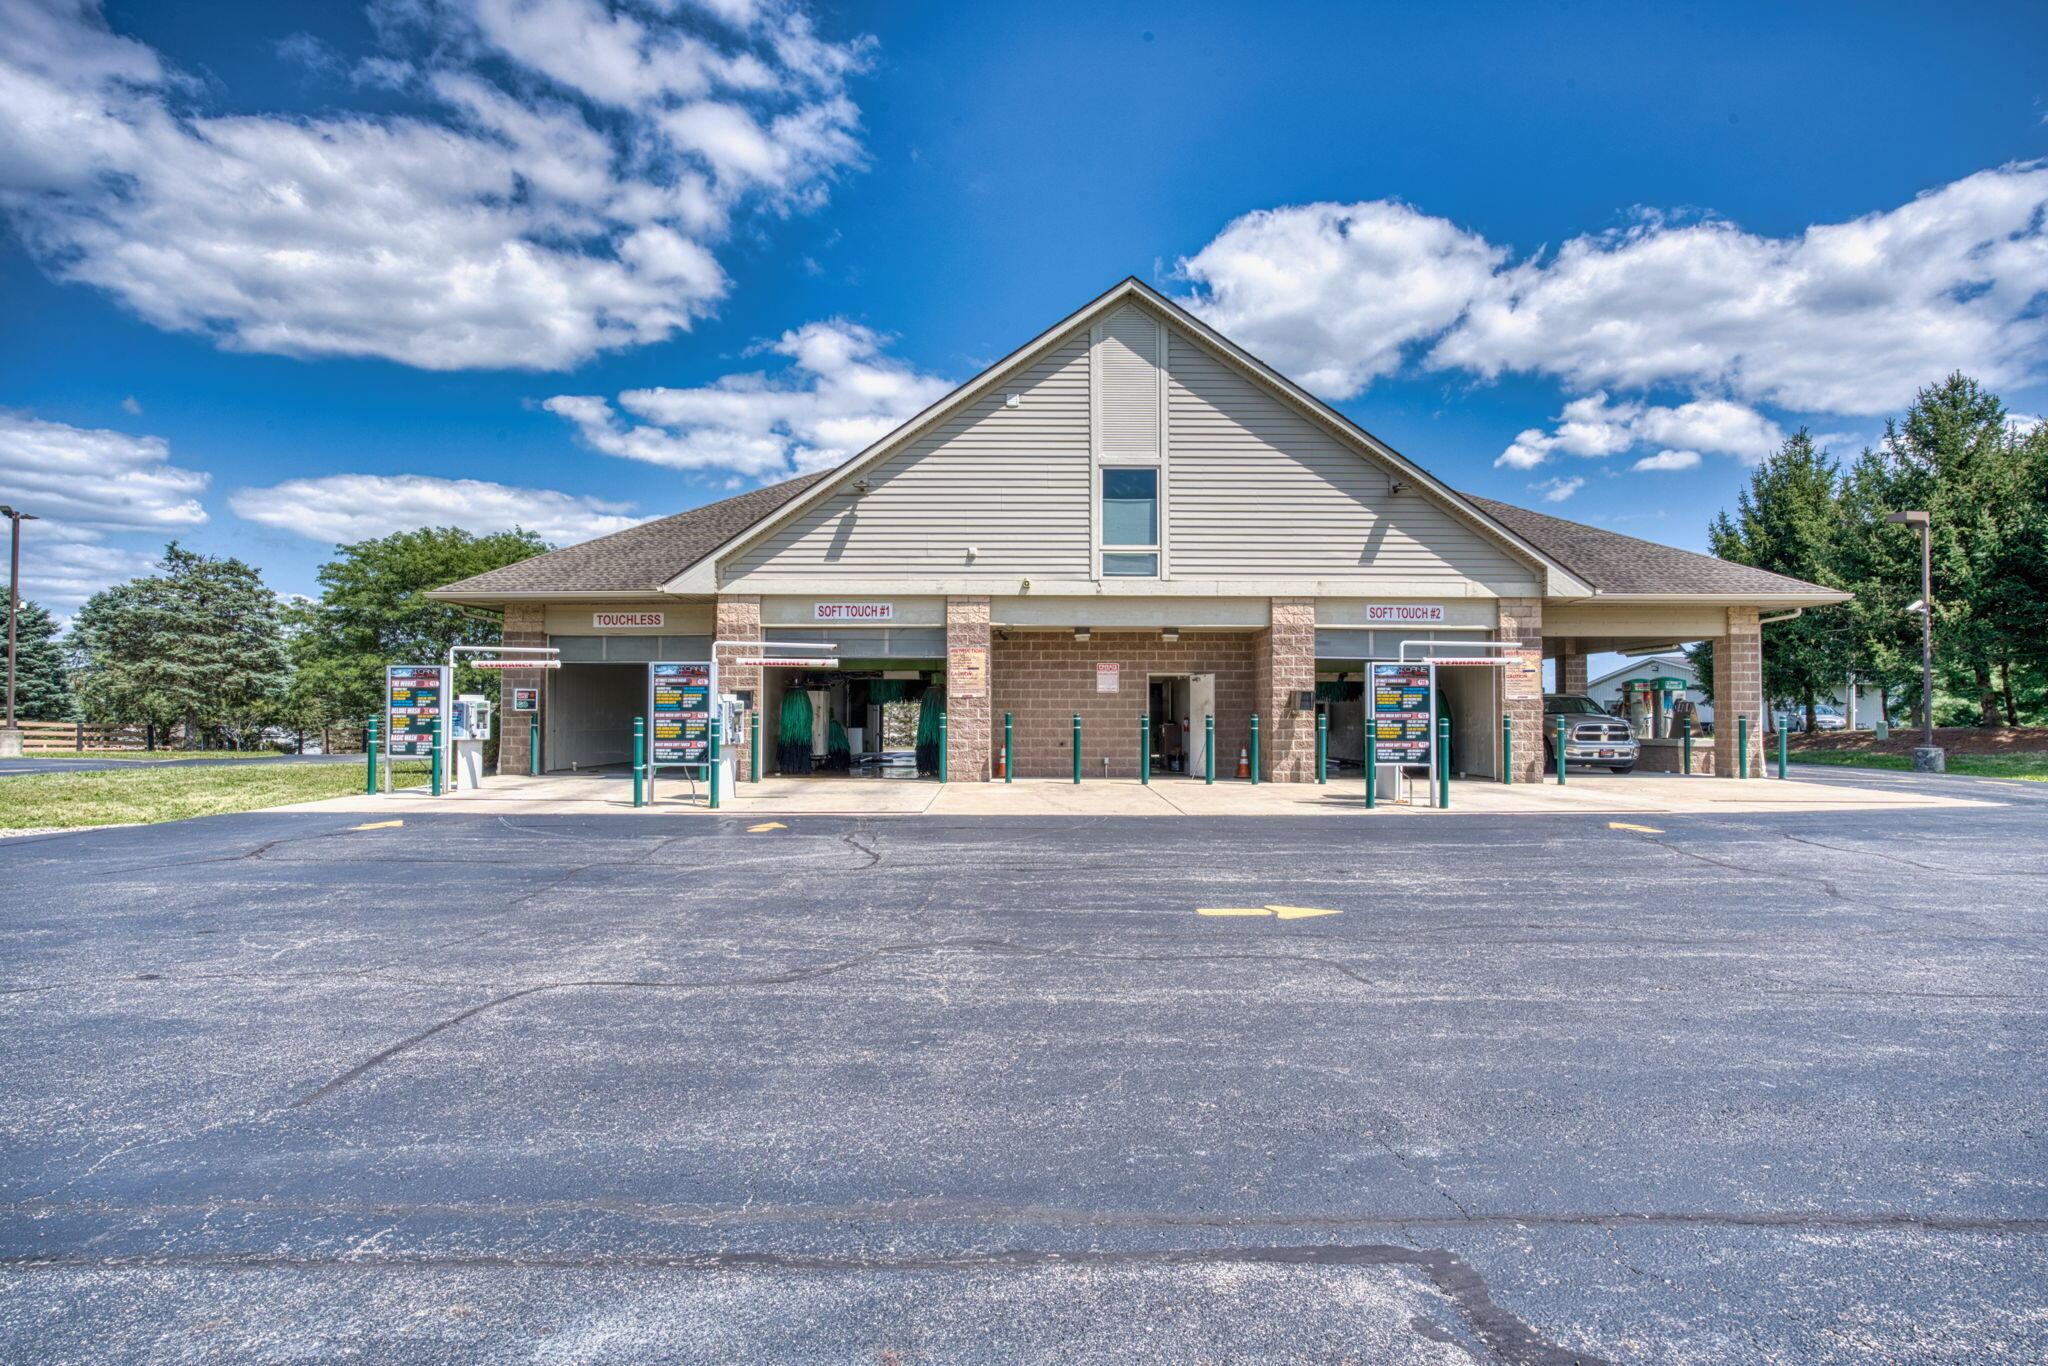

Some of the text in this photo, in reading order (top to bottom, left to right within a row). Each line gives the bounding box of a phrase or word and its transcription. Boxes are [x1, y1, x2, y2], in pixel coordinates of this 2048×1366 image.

[818, 605, 890, 617] SOFT TOUCH #1
[1369, 607, 1441, 619] SOFT TOUCH #2
[596, 614, 661, 626] TOUCHLESS
